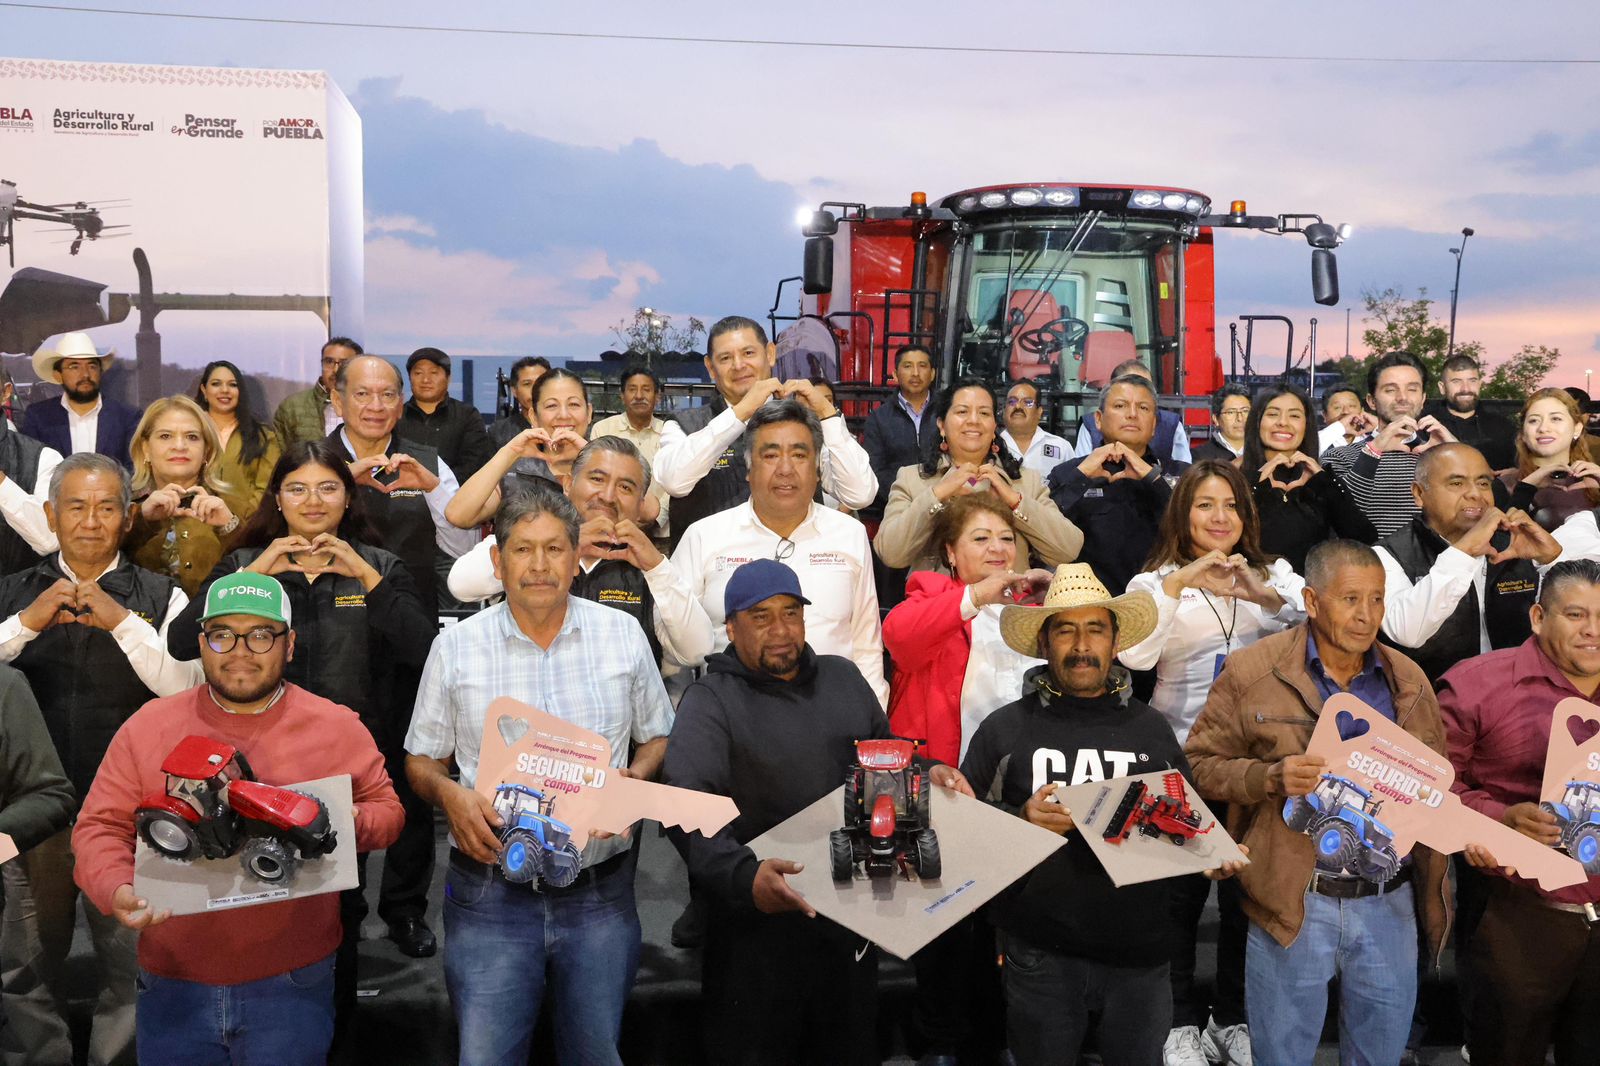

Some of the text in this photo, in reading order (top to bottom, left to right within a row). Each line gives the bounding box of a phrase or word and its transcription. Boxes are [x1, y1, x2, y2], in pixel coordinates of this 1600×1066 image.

[0, 107, 33, 120] BLA
[53, 108, 135, 123] Agricultura y
[53, 118, 154, 131] Desarrollo Rural
[185, 114, 237, 127] Pensar
[278, 118, 314, 127] AMOR
[187, 126, 244, 138] Grande
[263, 127, 324, 139] PUEBLA
[229, 586, 272, 600] TOREK
[543, 778, 581, 795] campo
[1373, 782, 1413, 805] campo
